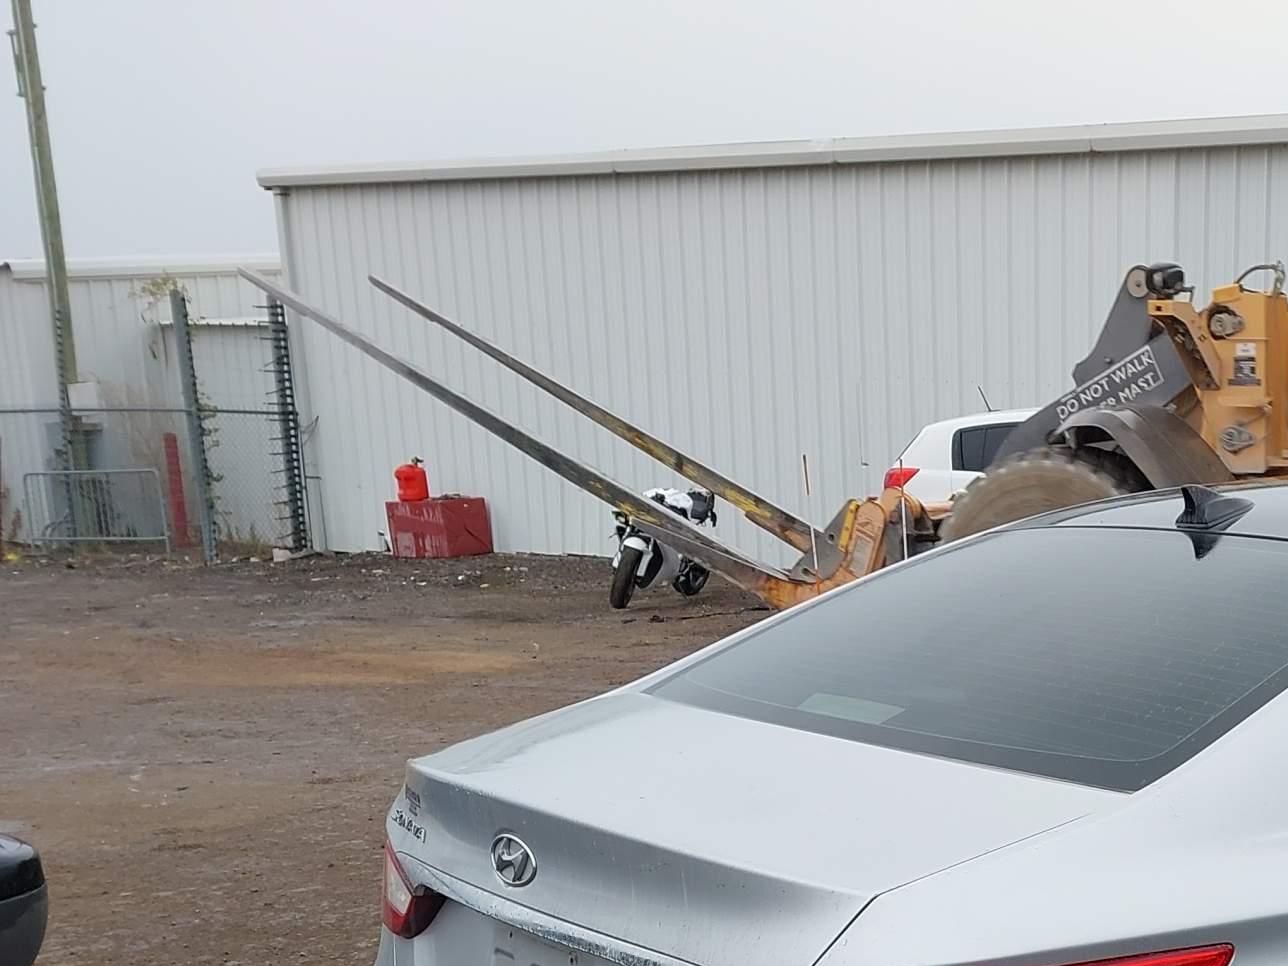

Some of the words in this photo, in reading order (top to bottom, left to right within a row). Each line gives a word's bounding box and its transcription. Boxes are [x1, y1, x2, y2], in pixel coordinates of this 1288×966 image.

[1056, 399, 1079, 419] DO
[1079, 378, 1110, 404] NOT
[1110, 352, 1153, 384] WALK
[1118, 372, 1157, 403] MAST
